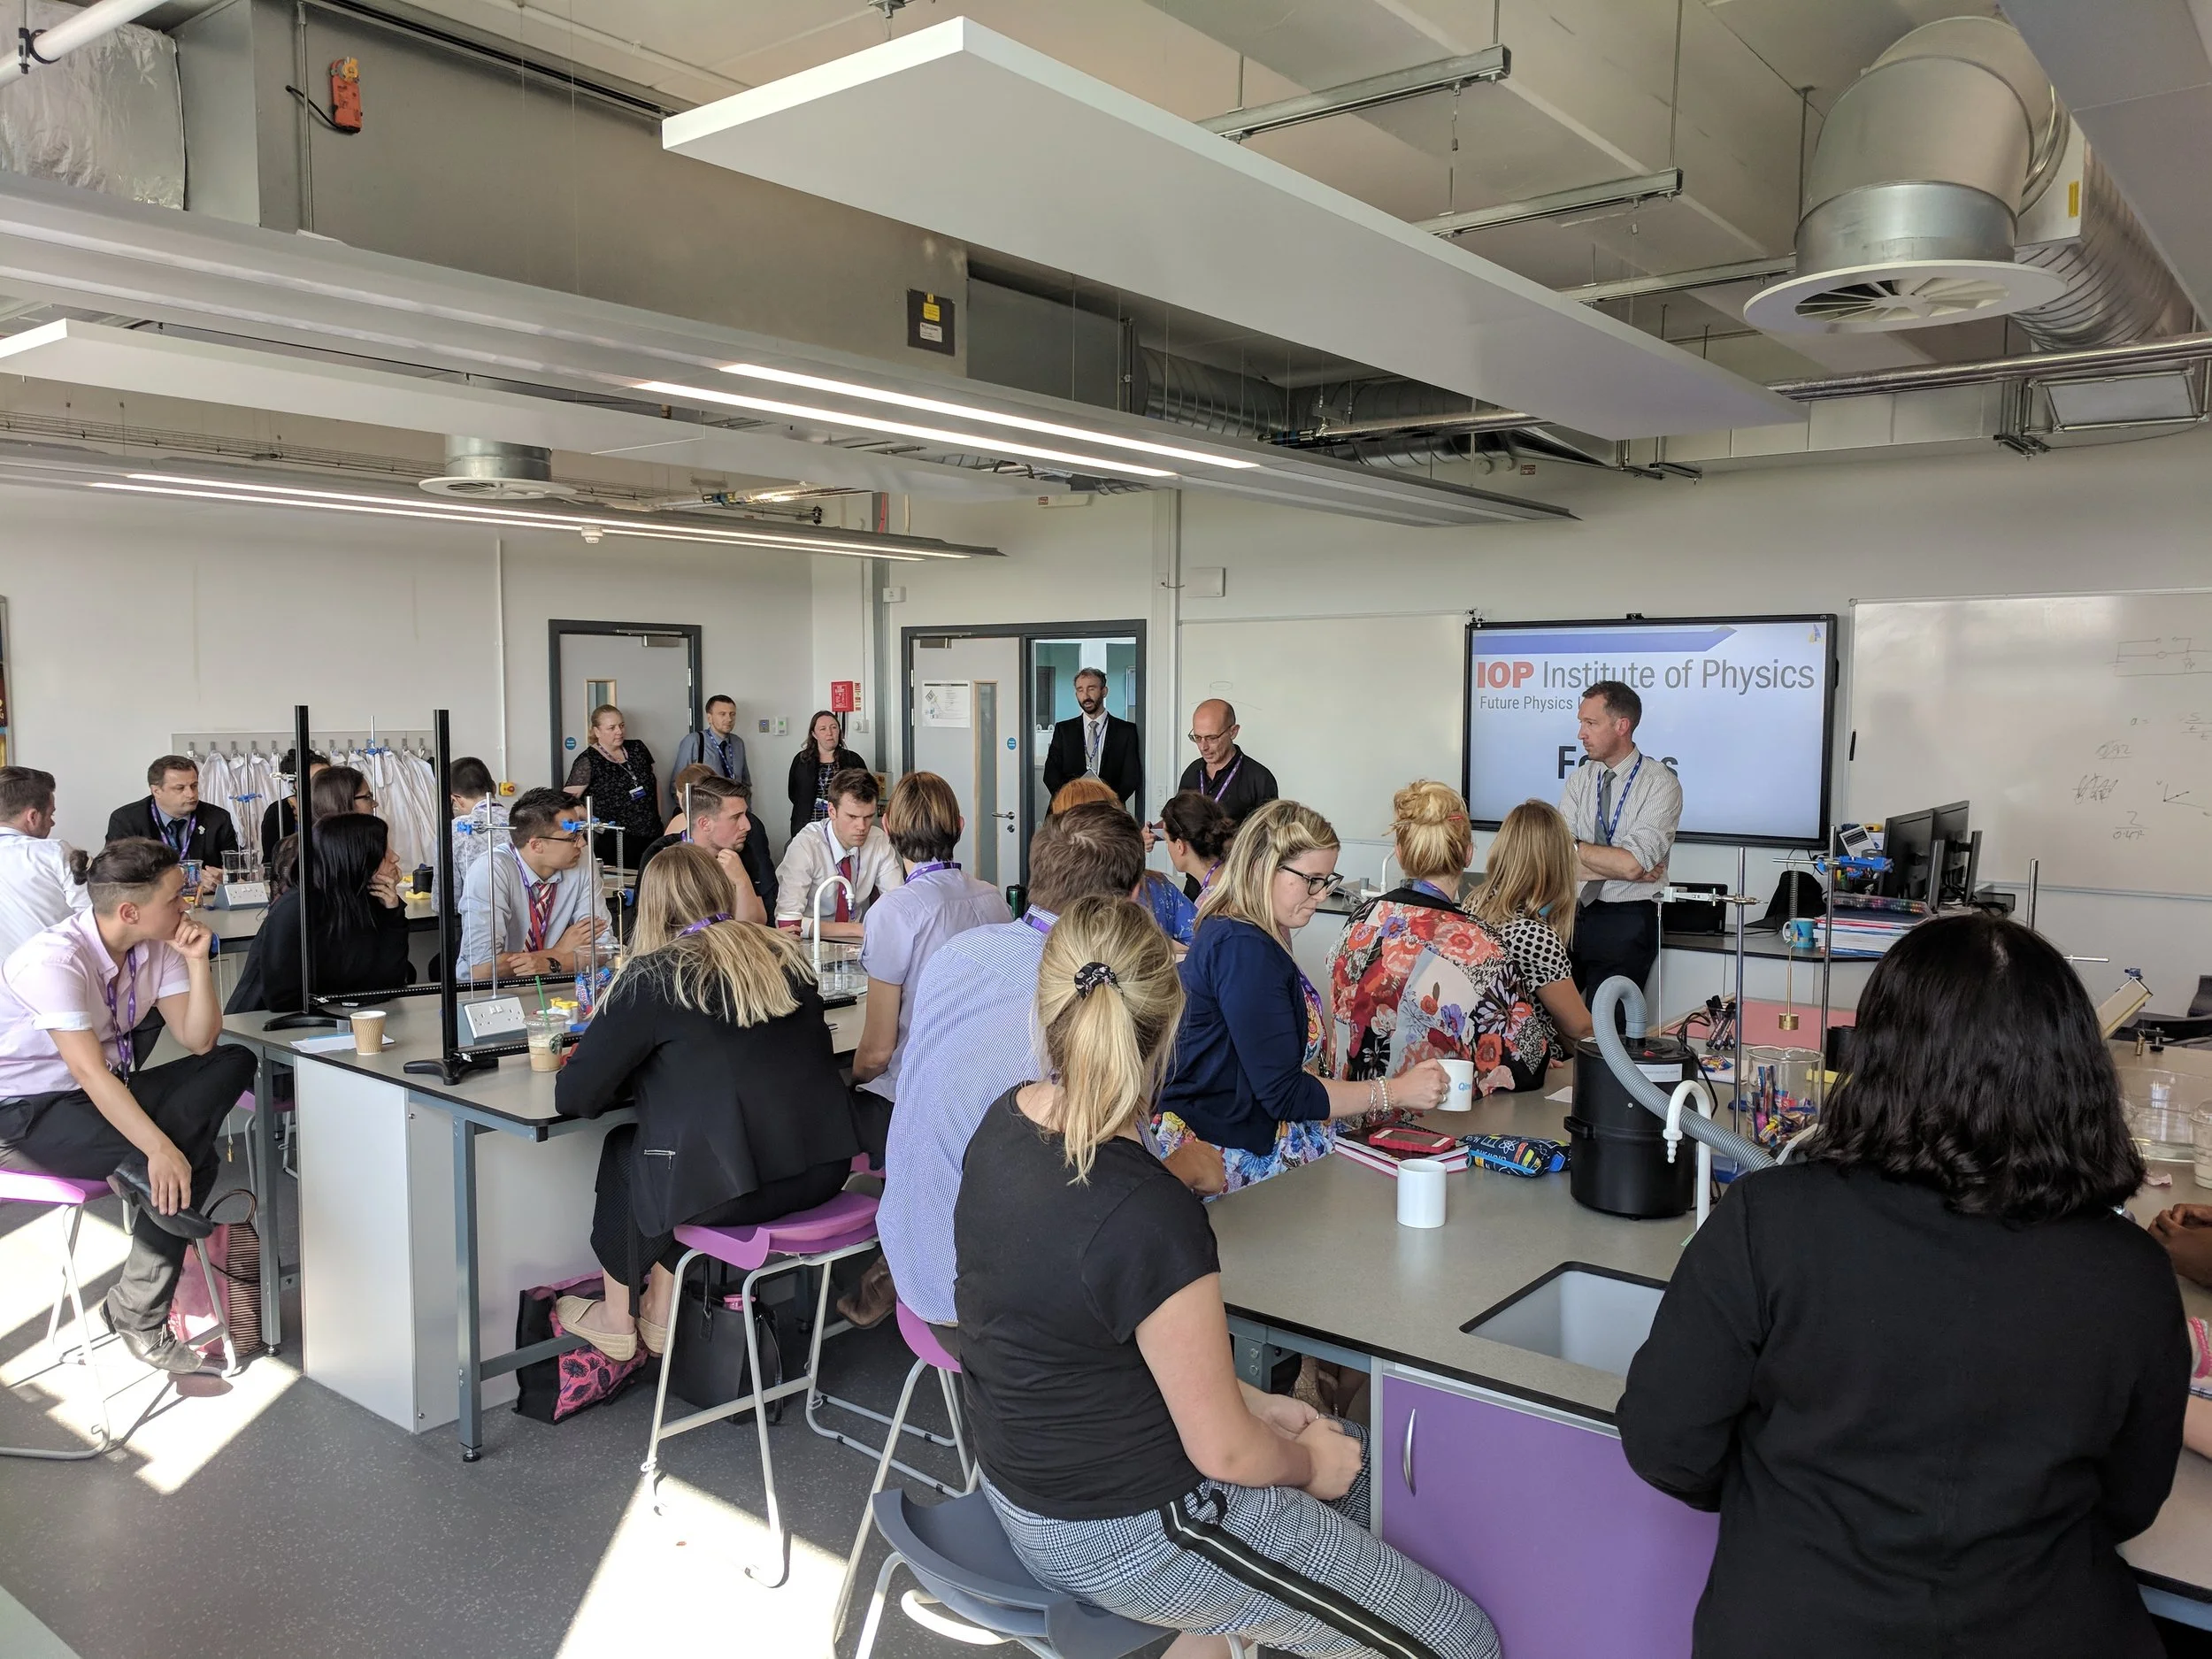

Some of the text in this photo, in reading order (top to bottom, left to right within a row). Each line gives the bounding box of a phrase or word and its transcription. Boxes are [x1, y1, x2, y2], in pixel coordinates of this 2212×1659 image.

[1477, 659, 1815, 695] IOP Institute of Physics
[1479, 695, 1519, 710] Future
[1524, 695, 1573, 712] Physics
